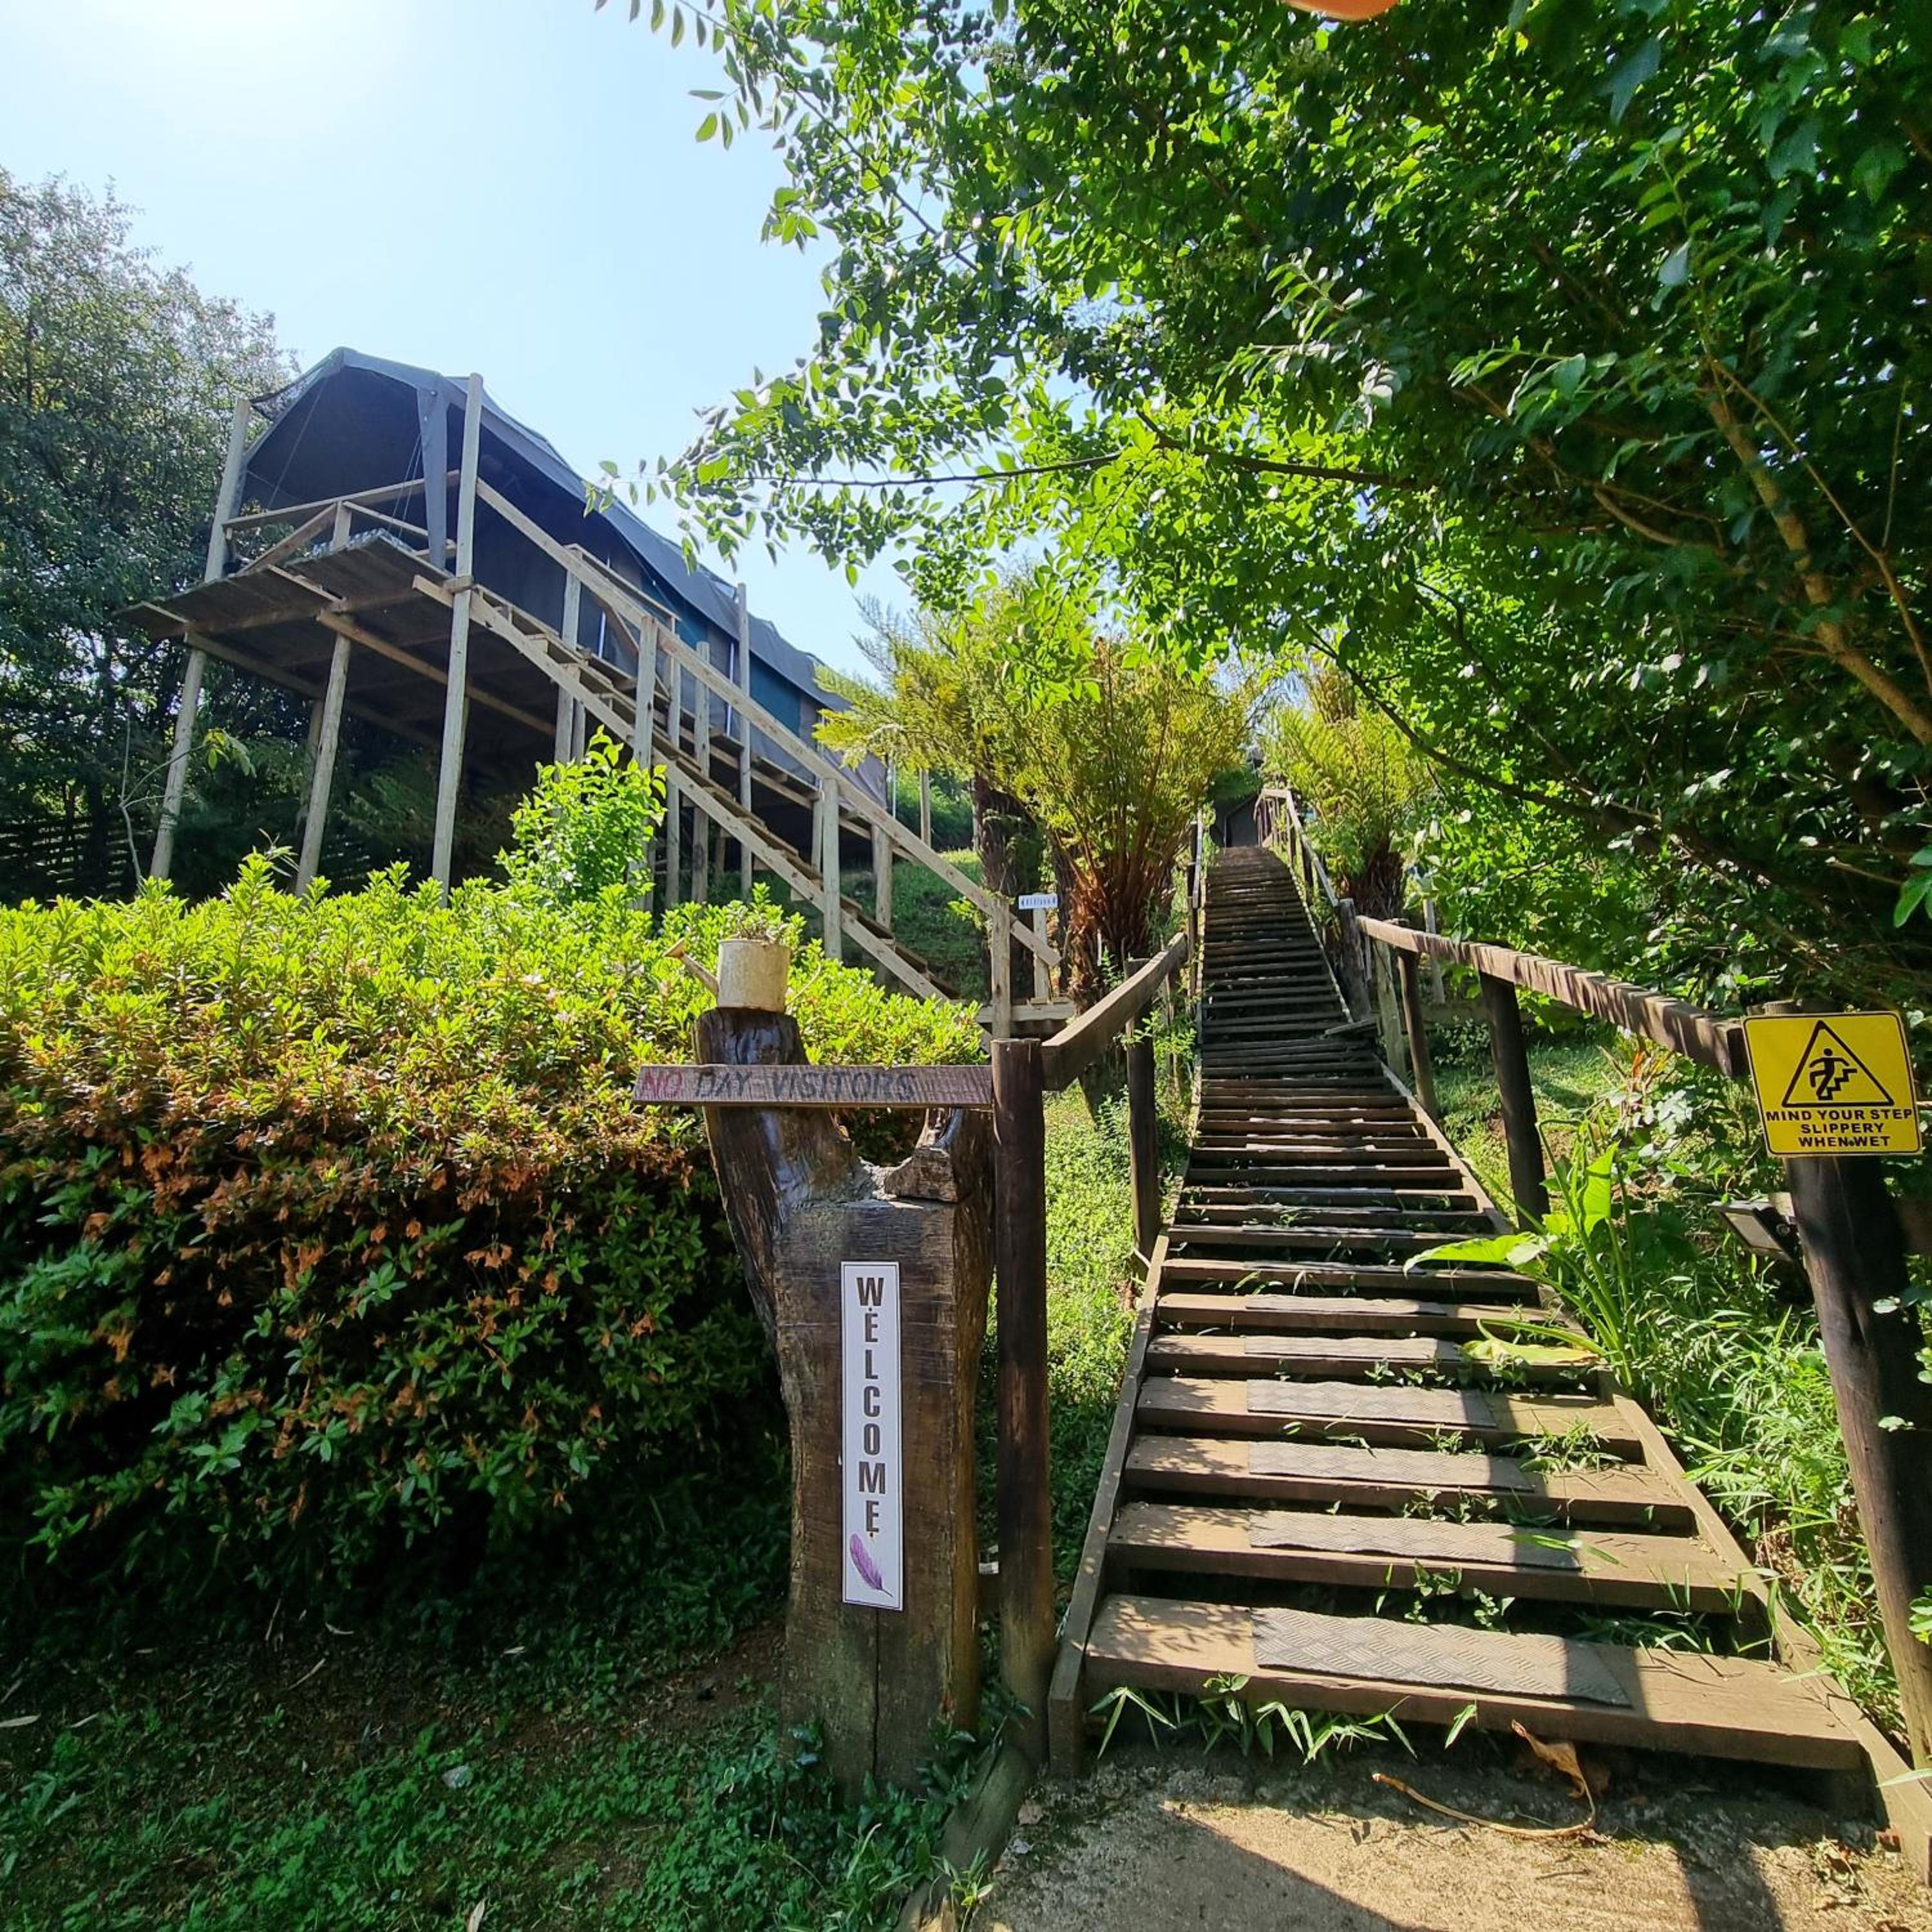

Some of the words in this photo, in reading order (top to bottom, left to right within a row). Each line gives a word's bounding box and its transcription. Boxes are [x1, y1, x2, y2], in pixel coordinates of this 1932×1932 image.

[772, 1071, 916, 1099] VISITORS
[1766, 1110, 1812, 1121] MIND
[1817, 1110, 1864, 1120] YOUR
[1871, 1109, 1912, 1119] STEP
[1801, 1122, 1884, 1133] SLIPPERY
[1798, 1136, 1849, 1147] WHEN
[1855, 1135, 1891, 1146] WET
[857, 1277, 886, 1533] WELCOME
